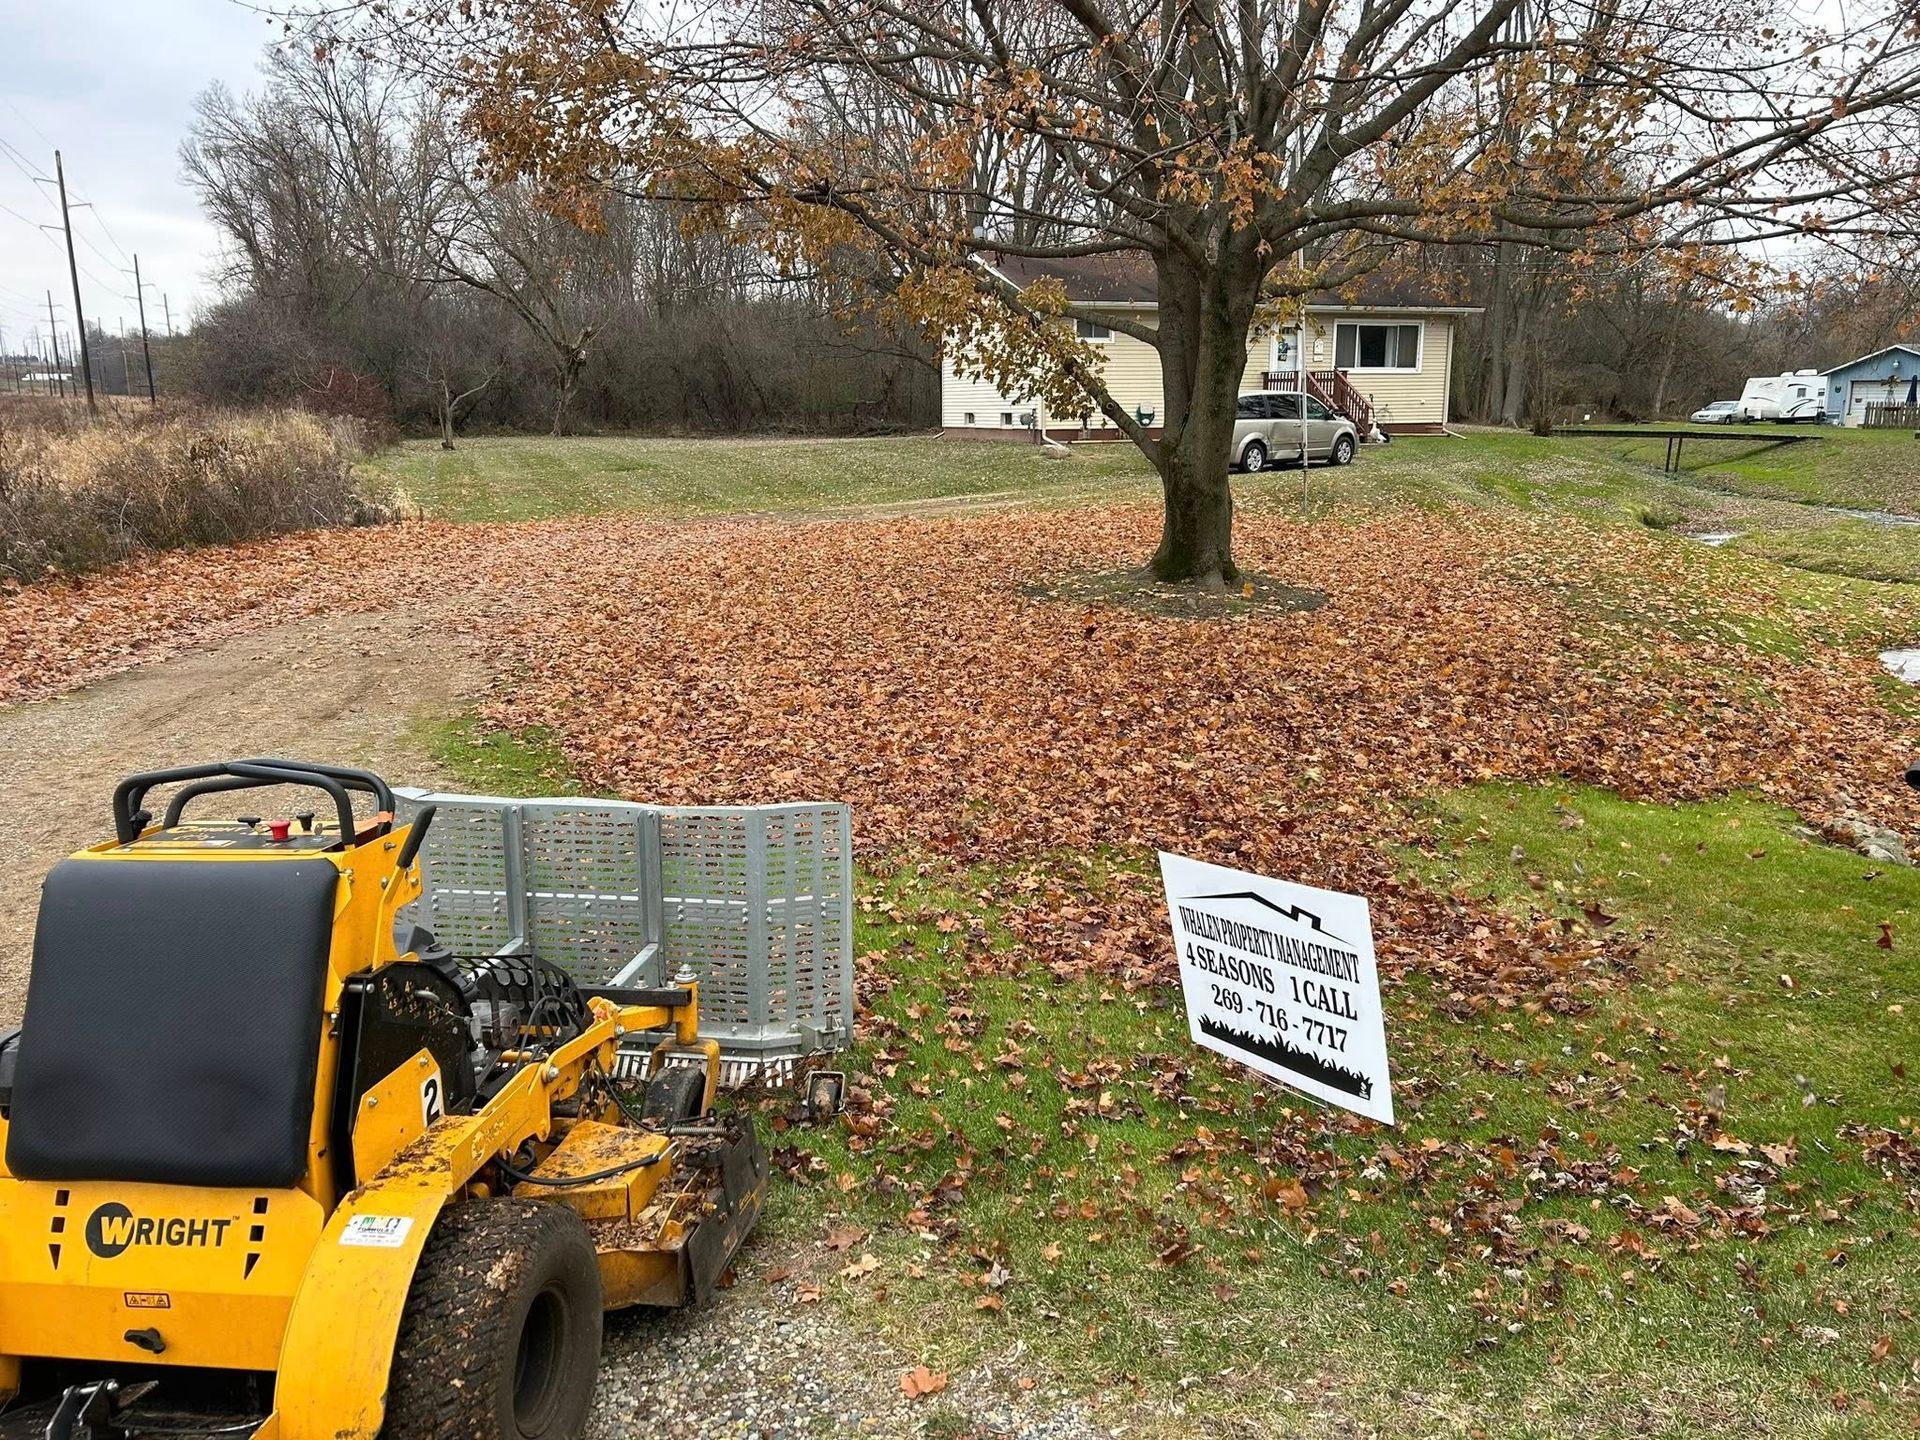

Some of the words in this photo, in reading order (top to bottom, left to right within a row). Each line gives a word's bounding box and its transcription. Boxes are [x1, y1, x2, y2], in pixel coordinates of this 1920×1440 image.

[1179, 905, 1222, 943] WHALEN
[1221, 918, 1275, 960] PROPERTY
[1274, 933, 1360, 984] MANAGEMENT
[1186, 942, 1197, 966] 4
[1197, 945, 1275, 994] SEASONS
[1290, 976, 1301, 1003] 1
[1303, 980, 1358, 1021] CALL
[424, 1079, 440, 1127] 2
[101, 1216, 231, 1247] WRIGHT
